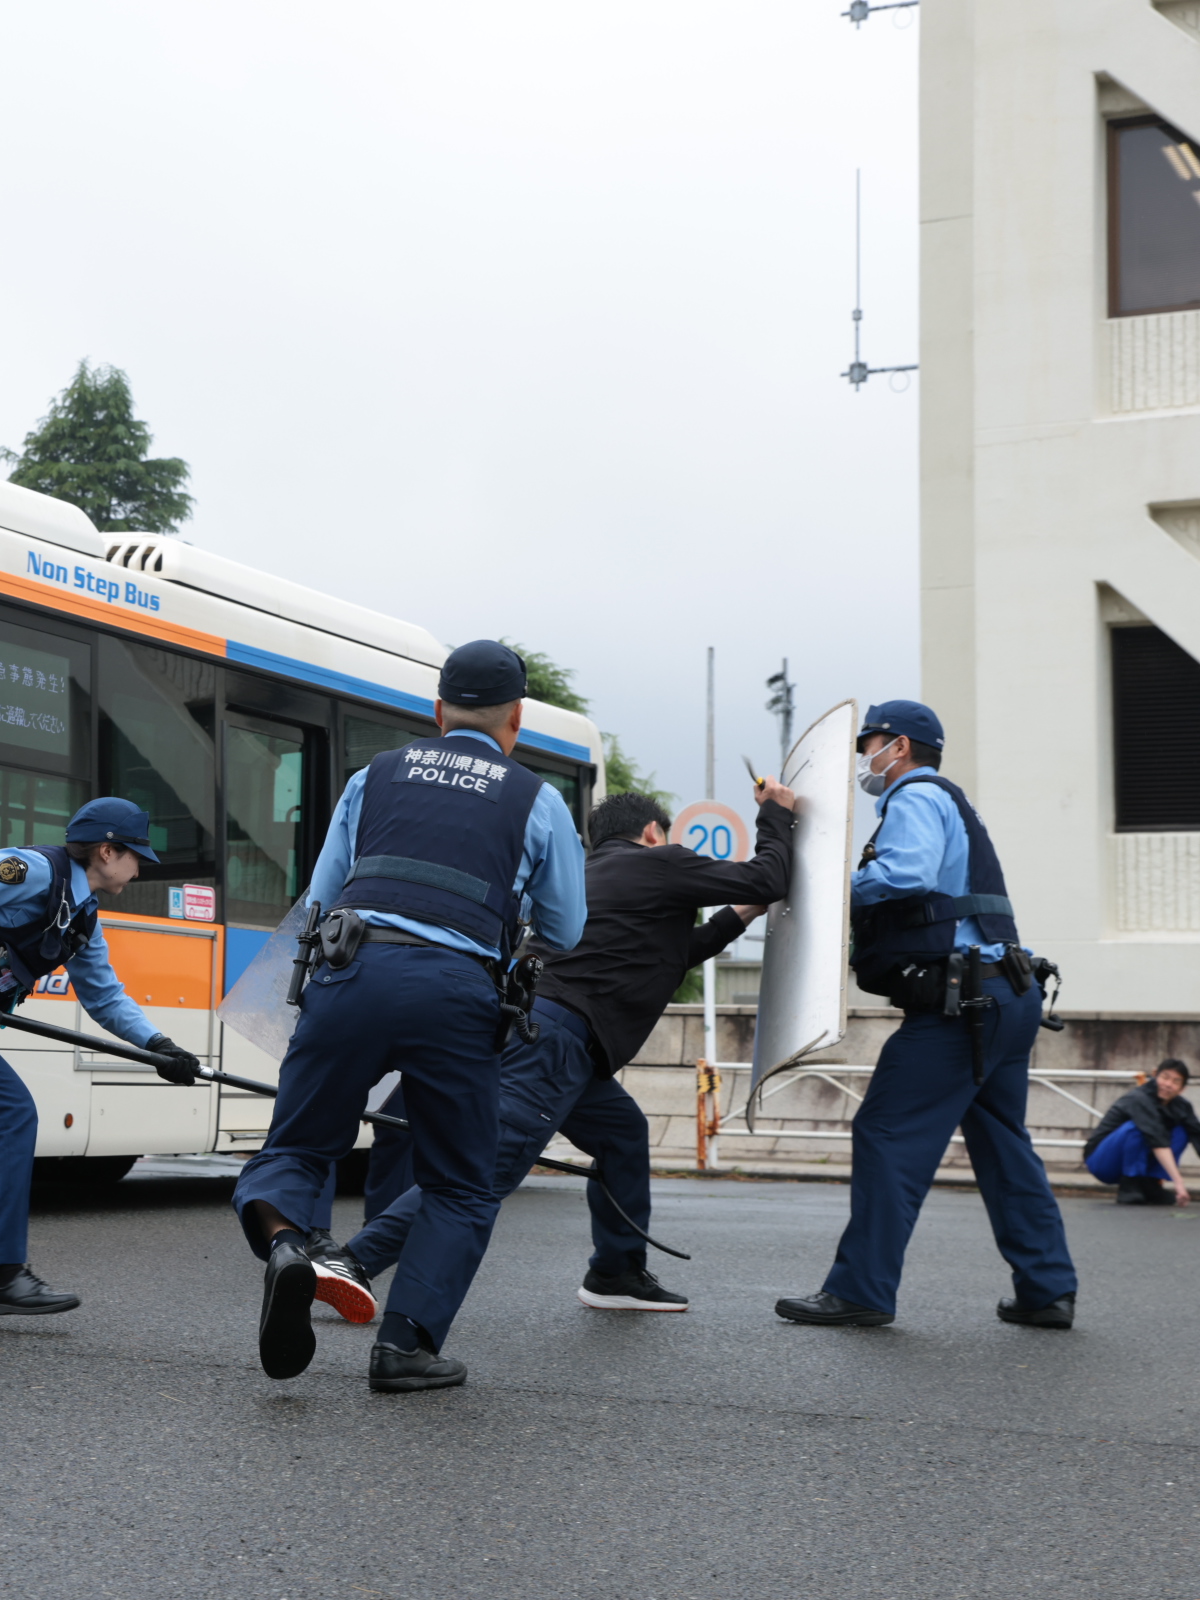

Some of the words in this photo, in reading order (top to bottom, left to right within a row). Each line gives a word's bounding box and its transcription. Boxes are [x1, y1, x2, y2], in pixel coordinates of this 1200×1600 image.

[27, 551, 68, 584] Non
[74, 566, 120, 603] Step
[124, 582, 160, 611] Bus
[405, 748, 508, 781] 神奈川県警察
[408, 767, 490, 793] POLICE
[688, 824, 732, 859] 20
